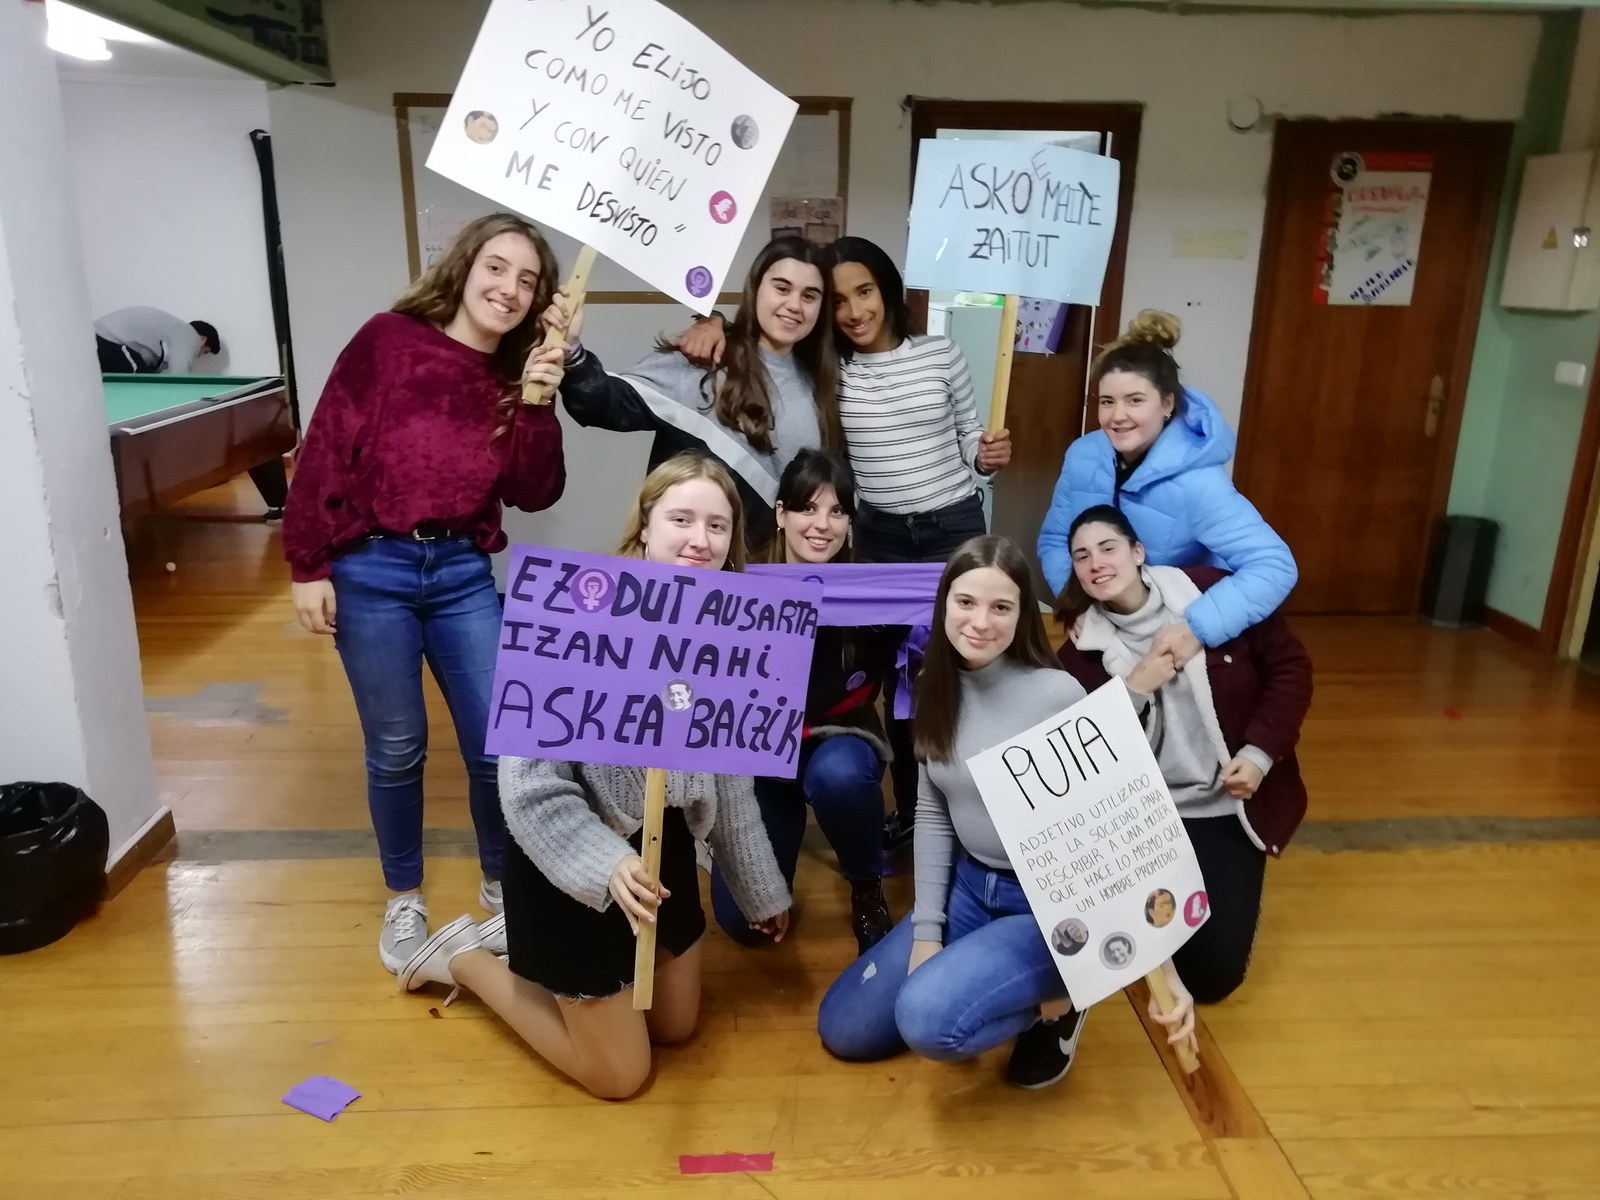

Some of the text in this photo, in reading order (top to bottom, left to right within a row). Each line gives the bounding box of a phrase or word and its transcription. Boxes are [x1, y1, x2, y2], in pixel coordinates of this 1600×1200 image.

[575, 5, 615, 52] YO
[524, 49, 608, 95] COMO
[613, 89, 651, 120] ME
[519, 98, 550, 131] Y
[554, 121, 609, 153] CON
[505, 150, 559, 190] ME
[938, 162, 1032, 215] ASKO
[695, 589, 818, 639] AUSARTA
[502, 620, 633, 670] IZAN
[494, 679, 664, 748] ASKEA
[1001, 716, 1119, 810] PUTA
[1026, 850, 1058, 871] POR
[1065, 837, 1085, 853] LA
[1140, 788, 1165, 811] PARA
[1035, 803, 1172, 891] DESCRIBIR A UNA MUJER
[1049, 820, 1182, 903] QUE HACE LO MISMO QUE
[1076, 895, 1095, 913] UN
[1098, 874, 1136, 902] HOMBRE
